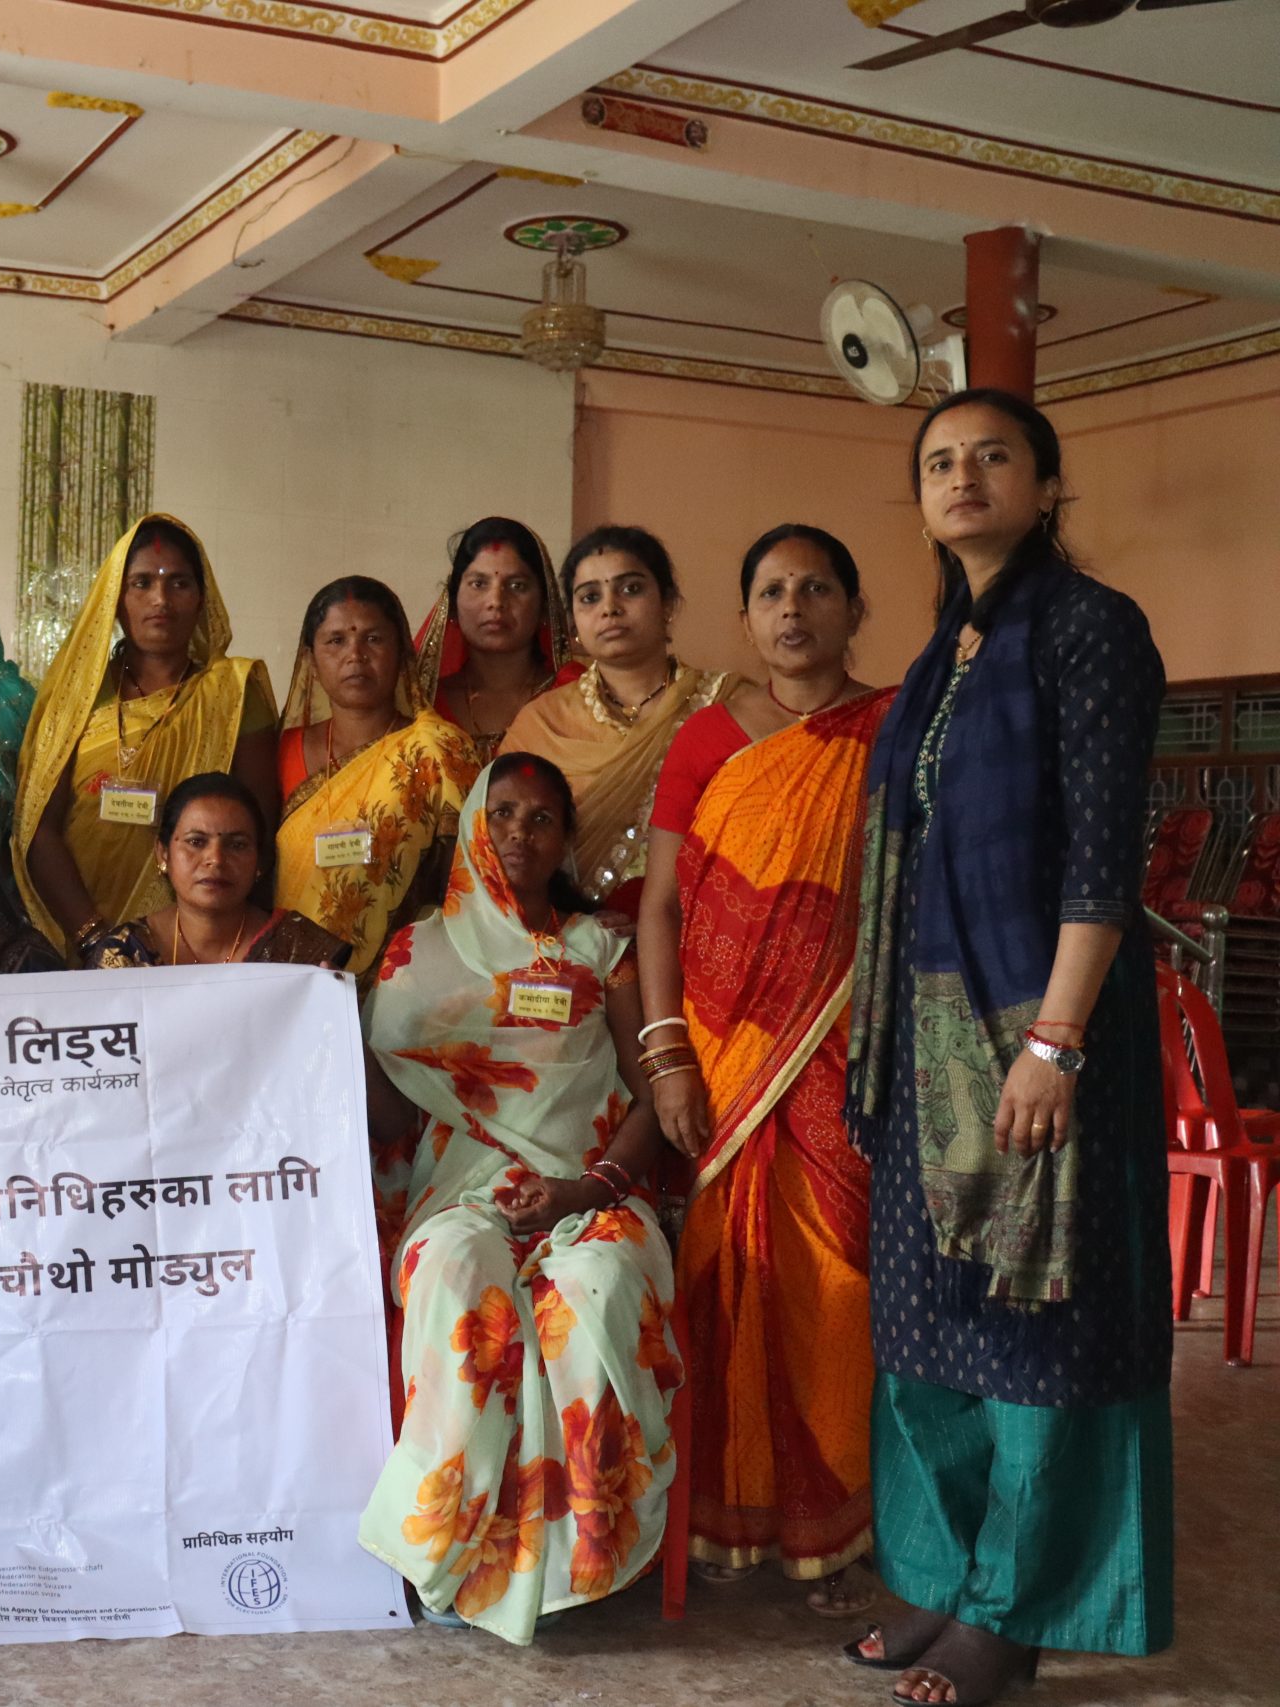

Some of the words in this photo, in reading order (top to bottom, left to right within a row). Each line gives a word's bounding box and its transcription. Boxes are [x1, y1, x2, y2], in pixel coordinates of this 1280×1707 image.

[0, 1075, 54, 1102] नेतृत्व
[61, 1069, 140, 1091] कार्यक्रम
[226, 1156, 320, 1201] लागि
[109, 1243, 256, 1296] मोड्युल
[182, 1530, 242, 1549] प्राविधिक
[246, 1526, 294, 1546] सहयोग
[250, 1568, 261, 1605] IFES
[11, 1606, 37, 1615] Agency
[50, 1607, 97, 1615] Development
